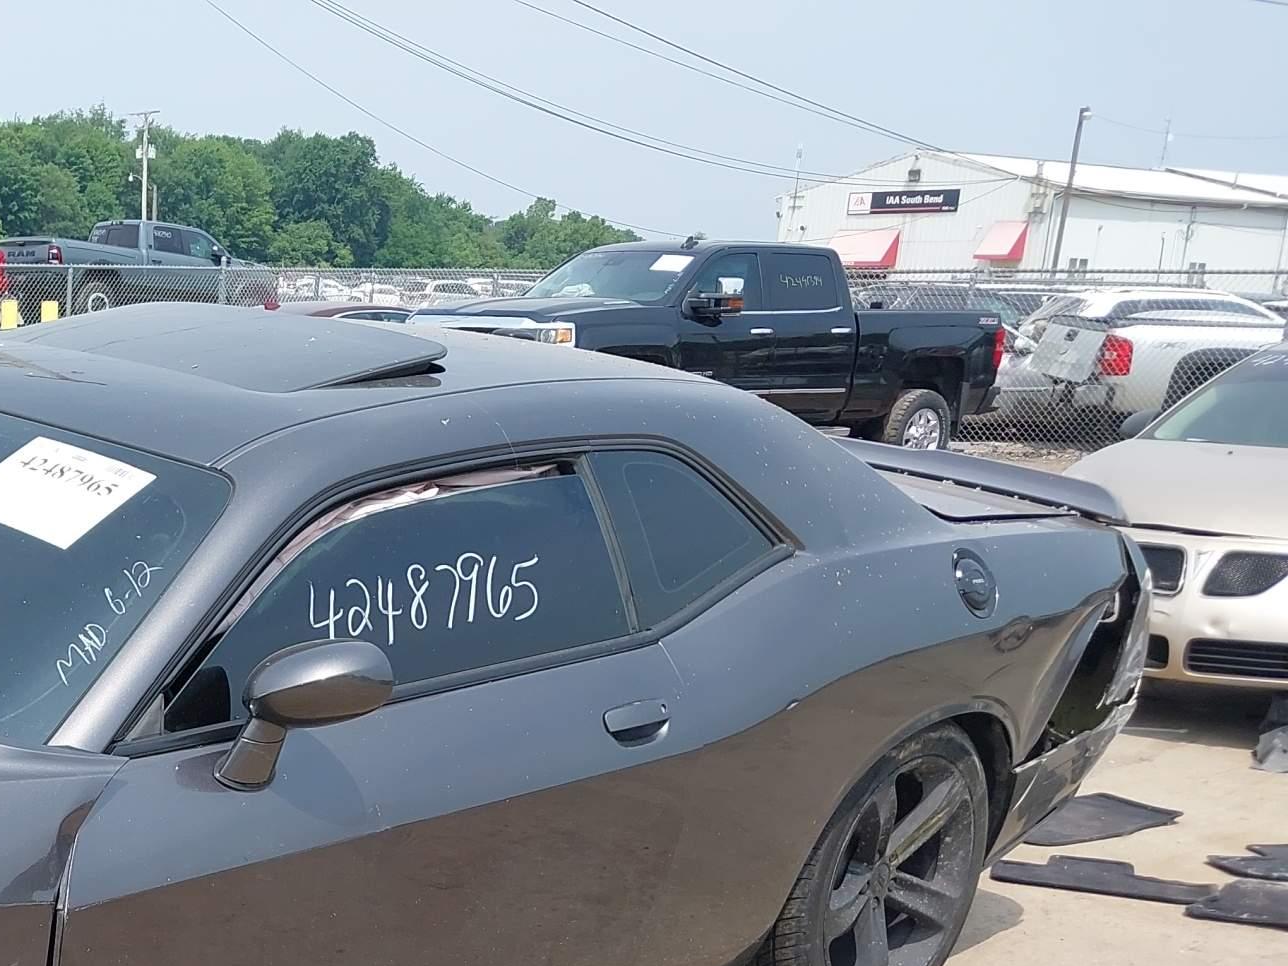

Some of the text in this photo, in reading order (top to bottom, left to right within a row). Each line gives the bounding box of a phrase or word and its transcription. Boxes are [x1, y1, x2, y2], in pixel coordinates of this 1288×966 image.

[901, 194, 923, 205] South
[924, 193, 944, 204] Bend
[8, 250, 36, 258] RAM
[19, 455, 120, 496] 42487965
[104, 561, 165, 615] 6-12
[309, 552, 539, 646] 42487965
